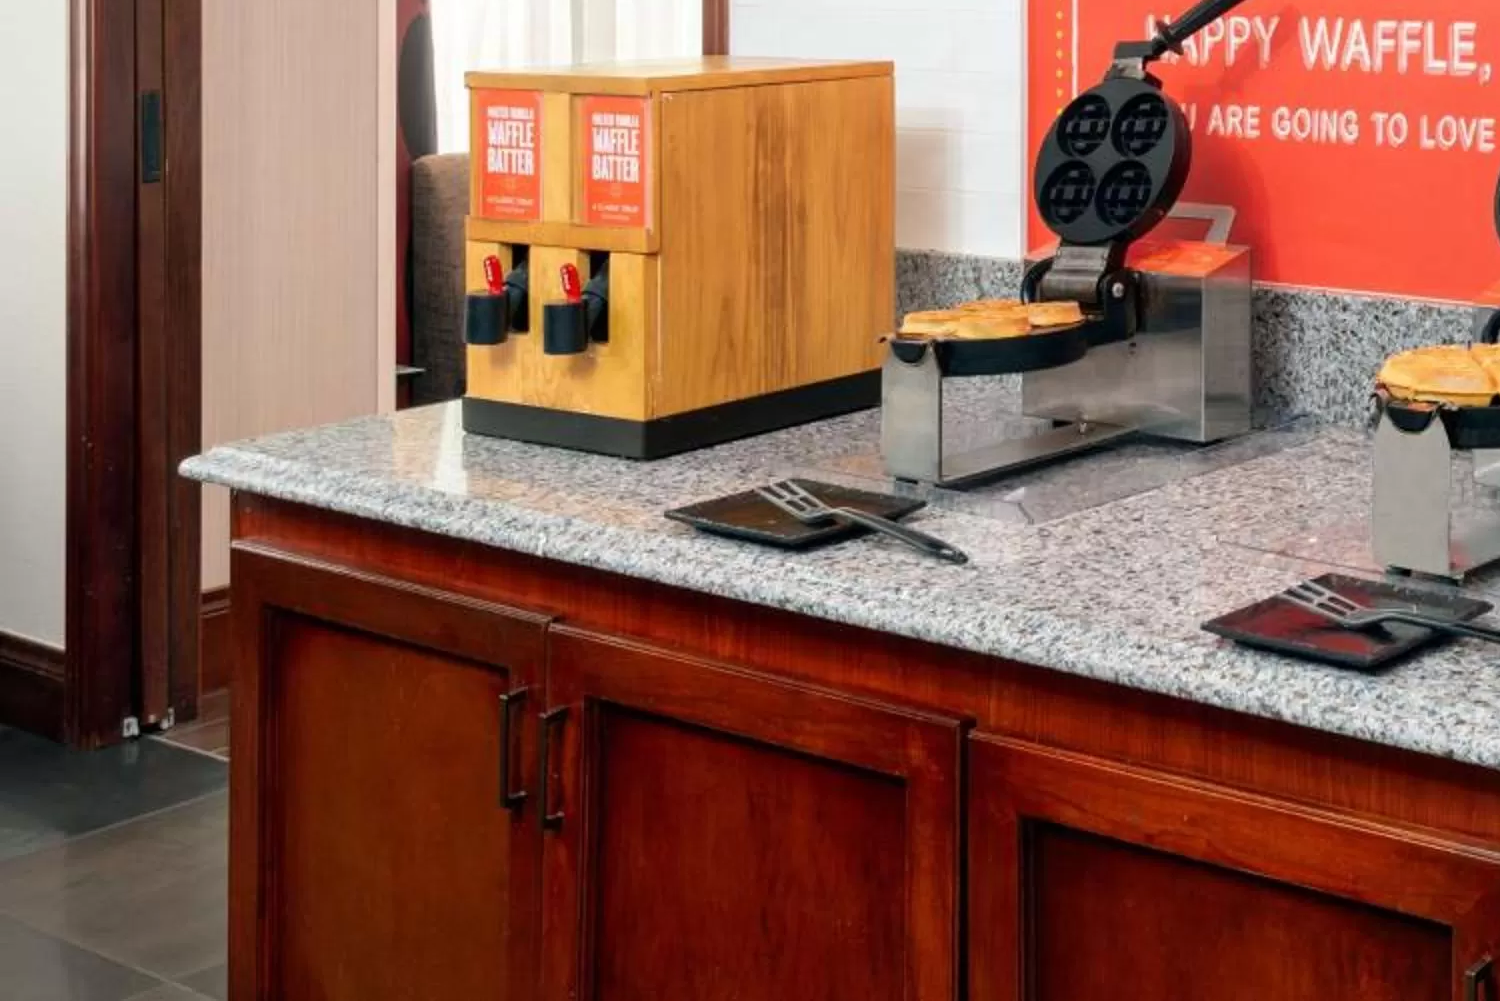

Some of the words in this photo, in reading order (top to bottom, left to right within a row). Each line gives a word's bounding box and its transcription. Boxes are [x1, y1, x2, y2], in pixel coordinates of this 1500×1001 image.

[1299, 16, 1491, 84] WAFFLE,
[488, 119, 535, 147] WAFFLE
[592, 127, 639, 155] WAFFLE
[1206, 104, 1261, 139] ARE
[1272, 106, 1359, 144] GOING
[1371, 112, 1407, 147] TO
[1420, 114, 1495, 154] LOVE
[487, 146, 534, 176] BATTER
[592, 154, 639, 183] BATTER
